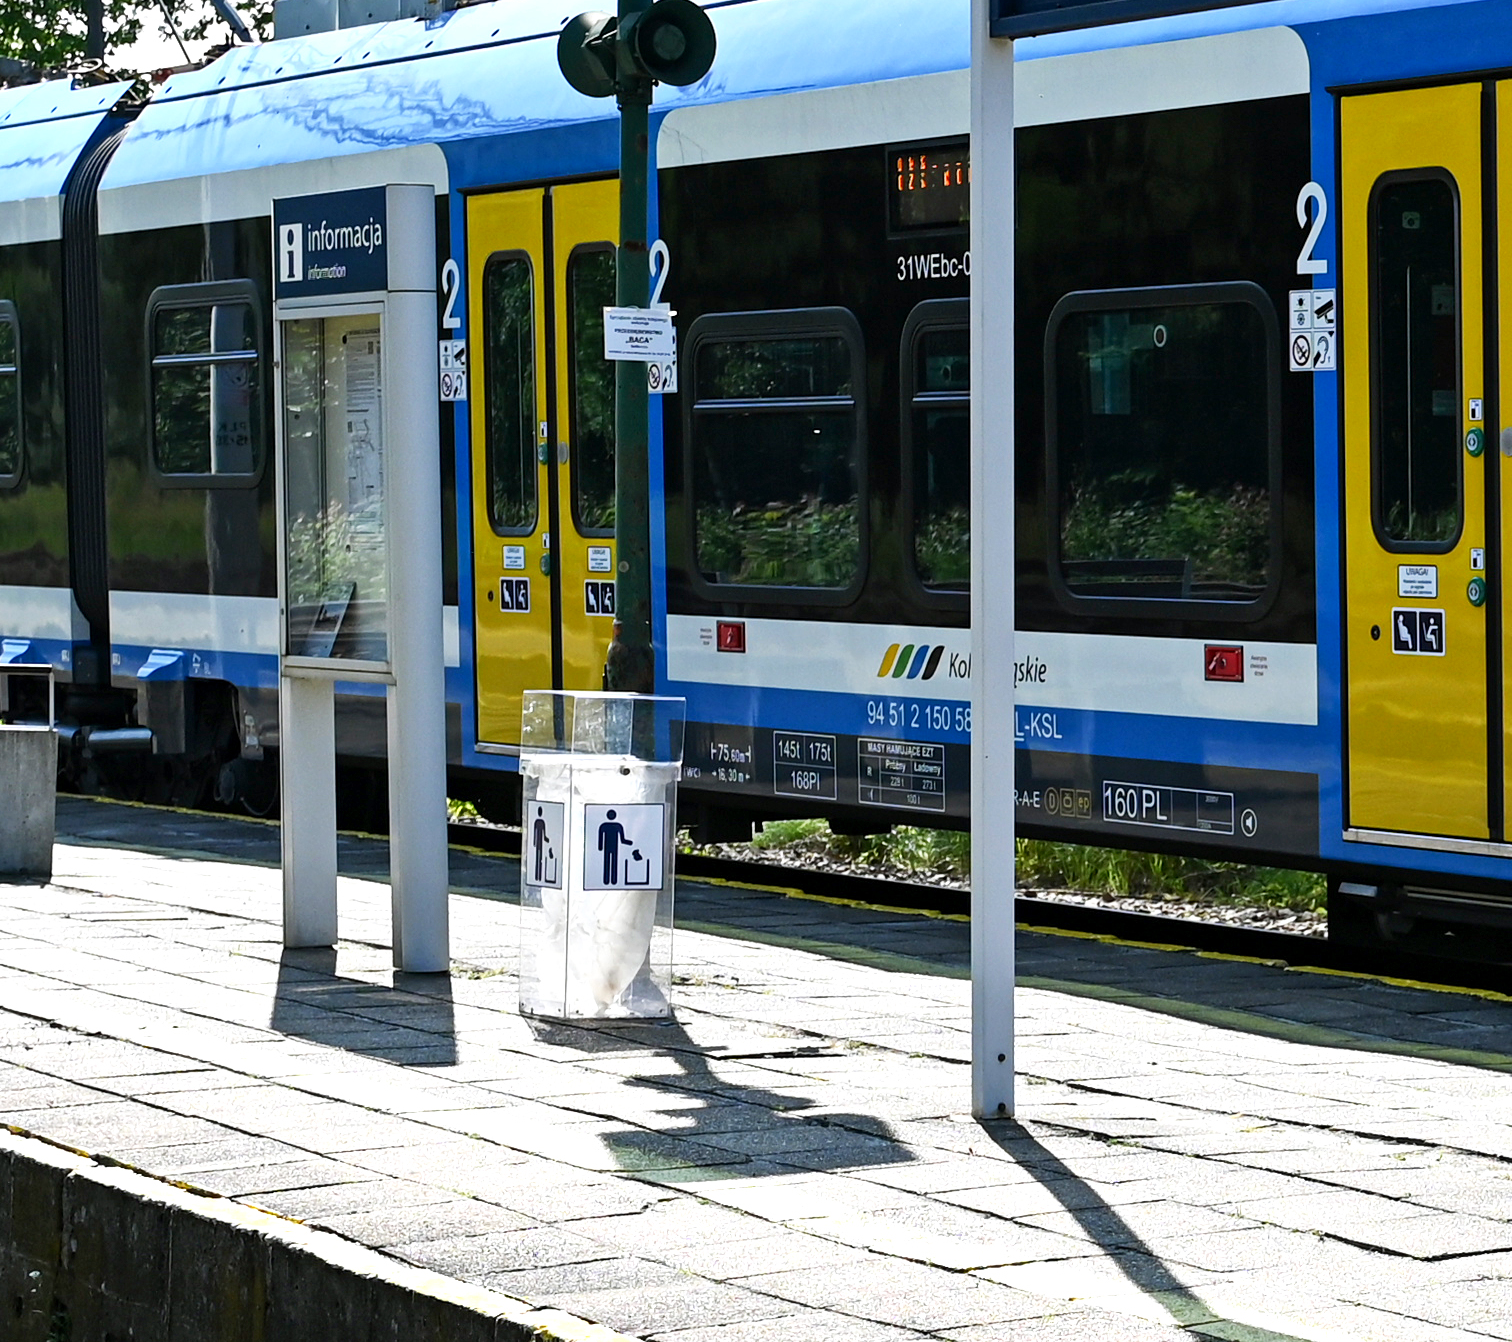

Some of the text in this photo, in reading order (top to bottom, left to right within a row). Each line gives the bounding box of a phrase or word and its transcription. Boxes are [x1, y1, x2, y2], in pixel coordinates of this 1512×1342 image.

[308, 217, 382, 254] informacja
[1297, 182, 1327, 275] 2
[649, 239, 670, 311] 2
[897, 251, 970, 281] 31WEbc-0
[442, 259, 461, 329] 2
[867, 700, 884, 725] 94
[889, 702, 905, 727] 51
[911, 704, 919, 728] 2
[925, 705, 951, 731] 150
[1014, 711, 1063, 740] L-KSL
[778, 740, 800, 759] 145t
[809, 742, 831, 762] 175t
[867, 743, 885, 754] MASY
[922, 748, 935, 758] EZT
[1104, 787, 1138, 818] 160
[1142, 789, 1168, 821] PL
